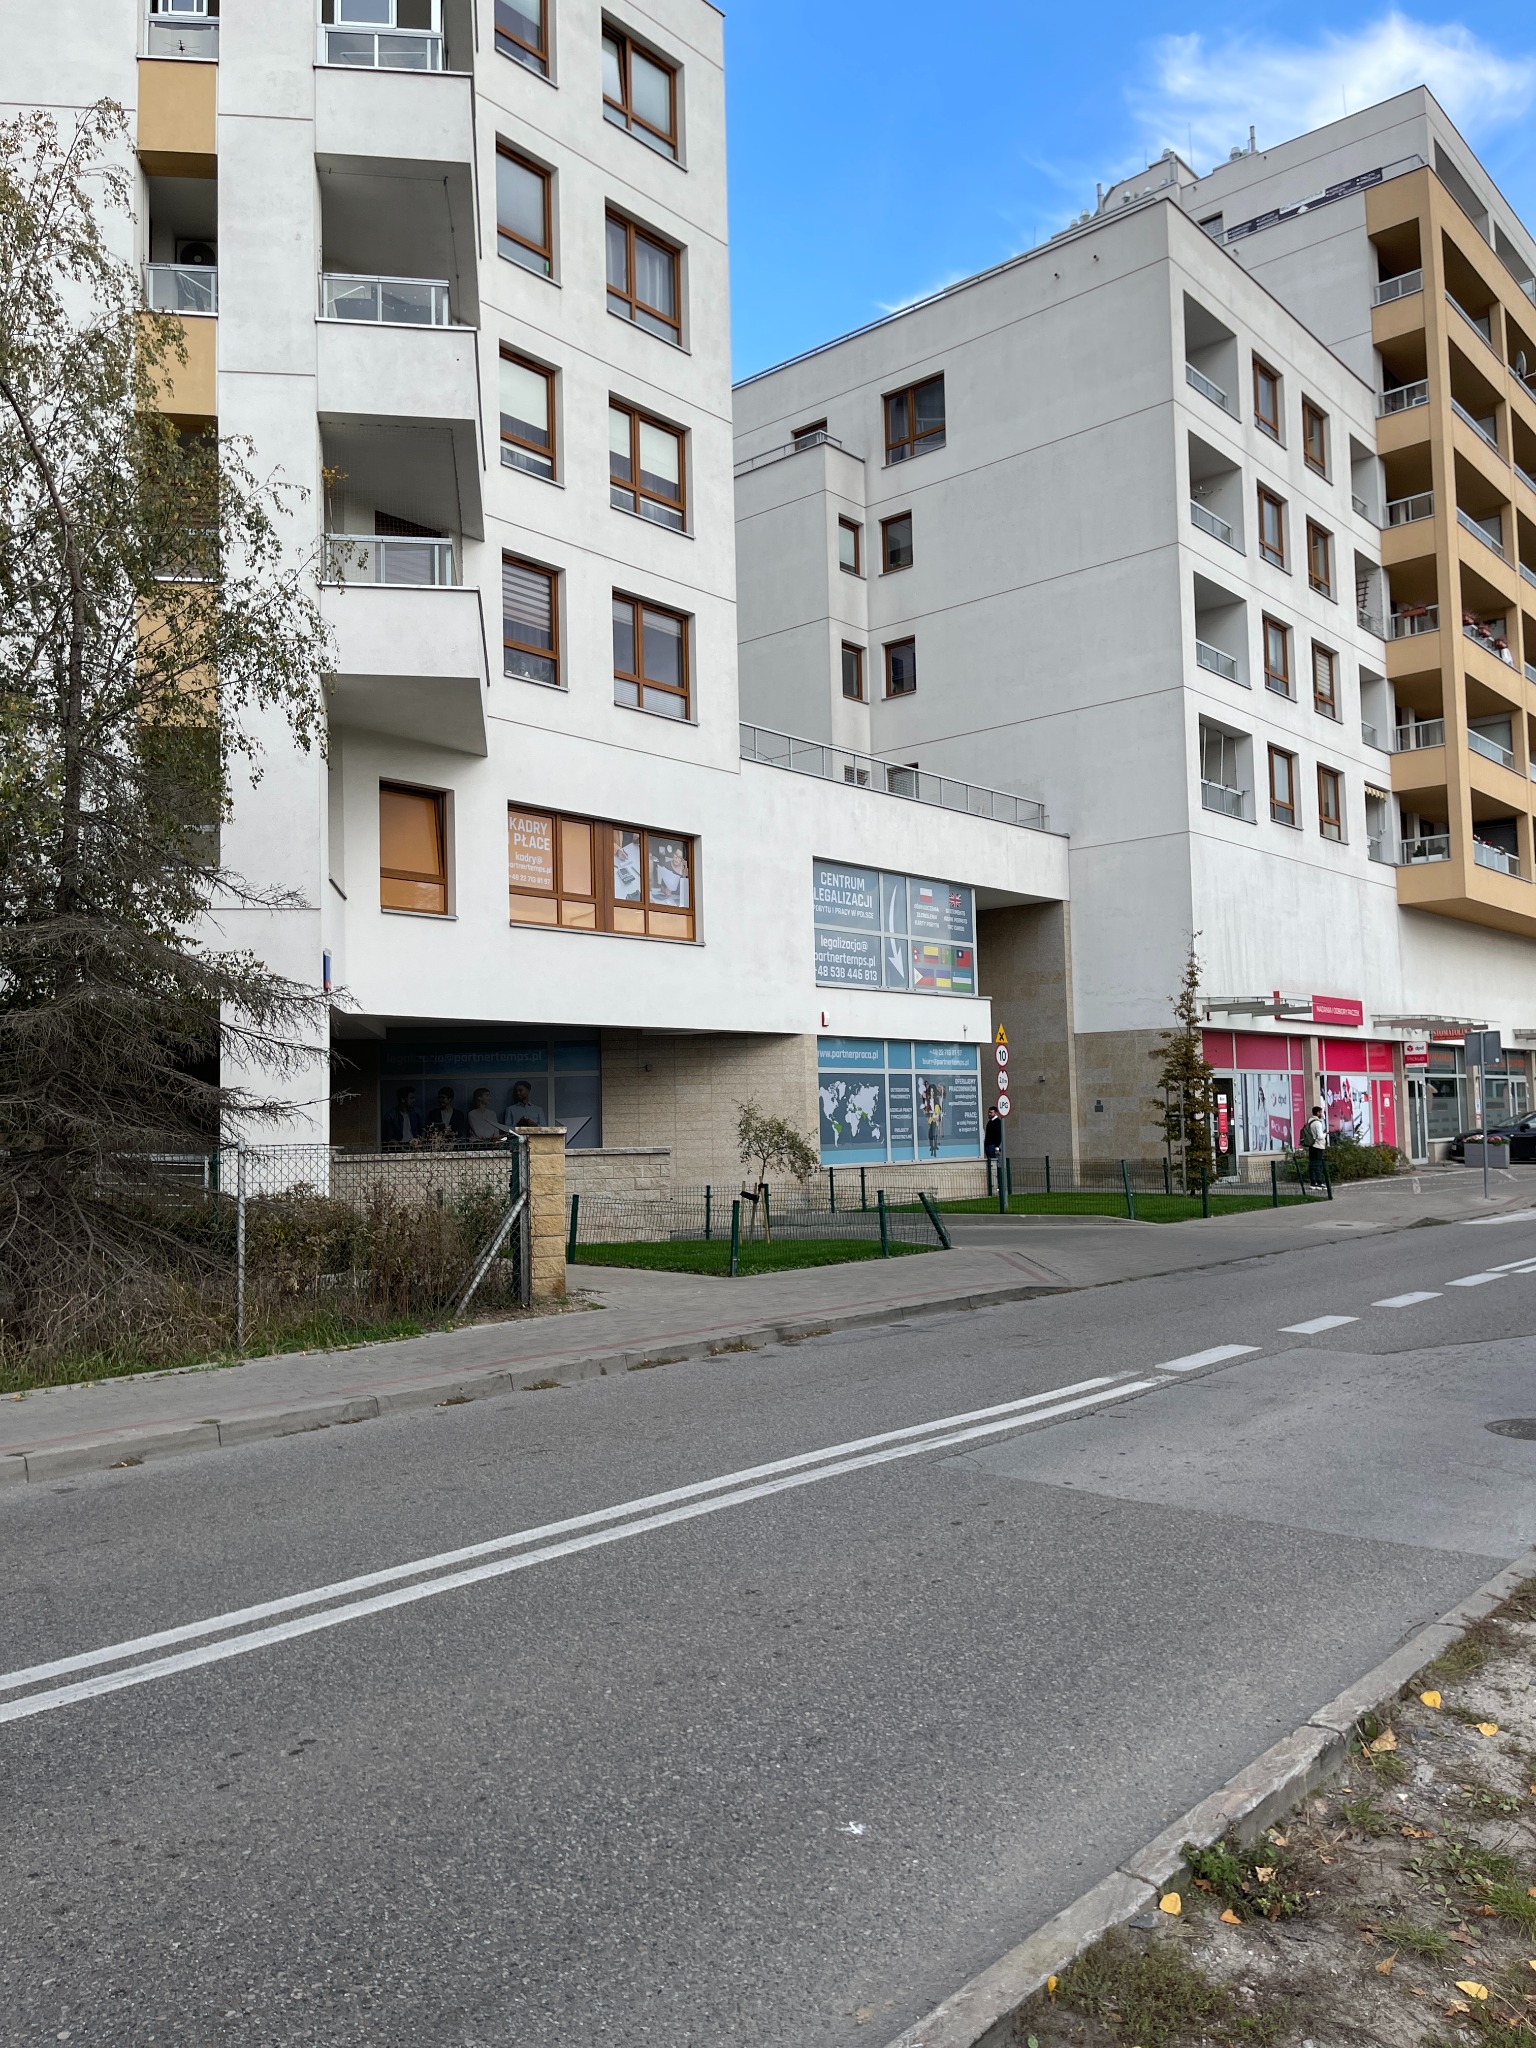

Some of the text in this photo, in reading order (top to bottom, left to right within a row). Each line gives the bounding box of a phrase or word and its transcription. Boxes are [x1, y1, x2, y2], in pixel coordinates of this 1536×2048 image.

[509, 817, 547, 835] KADRY
[514, 833, 550, 850] PŁACE
[516, 851, 542, 864] kadry@
[509, 862, 552, 874] artnertemps.pl
[821, 872, 865, 891] CENTRUM
[814, 887, 872, 908] LEGALIZACJI
[857, 911, 874, 919] POLSCE
[821, 935, 868, 952] legalizacja@
[815, 951, 876, 968] partnertemps.pl
[830, 966, 845, 978] 538
[847, 968, 862, 979] 446
[865, 969, 877, 981] 813
[999, 1050, 1006, 1061] 10
[1278, 1094, 1286, 1106] dpd
